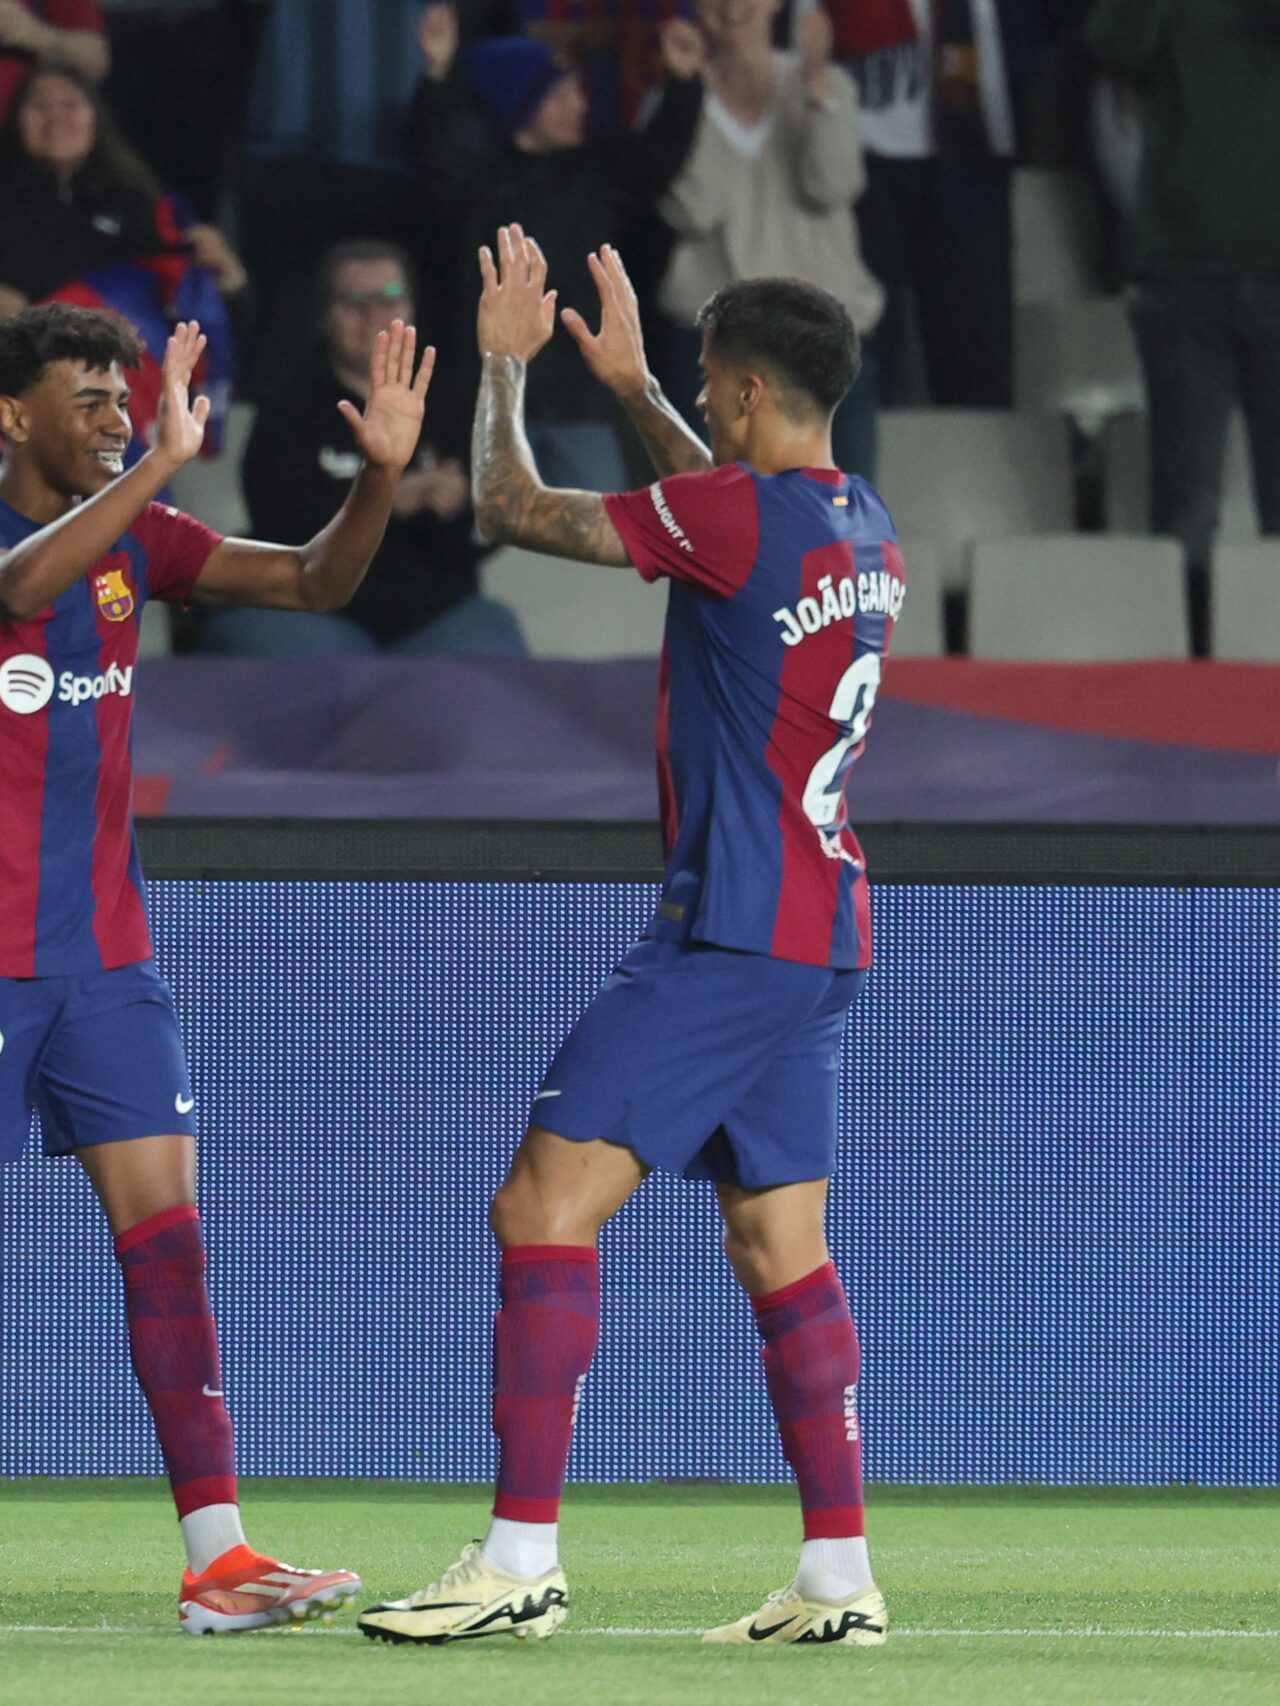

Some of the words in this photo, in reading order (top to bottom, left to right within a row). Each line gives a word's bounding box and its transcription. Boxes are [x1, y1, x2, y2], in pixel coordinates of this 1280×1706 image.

[772, 573, 857, 647] JOÃO
[857, 570, 907, 622] CANC
[802, 652, 881, 827] 2
